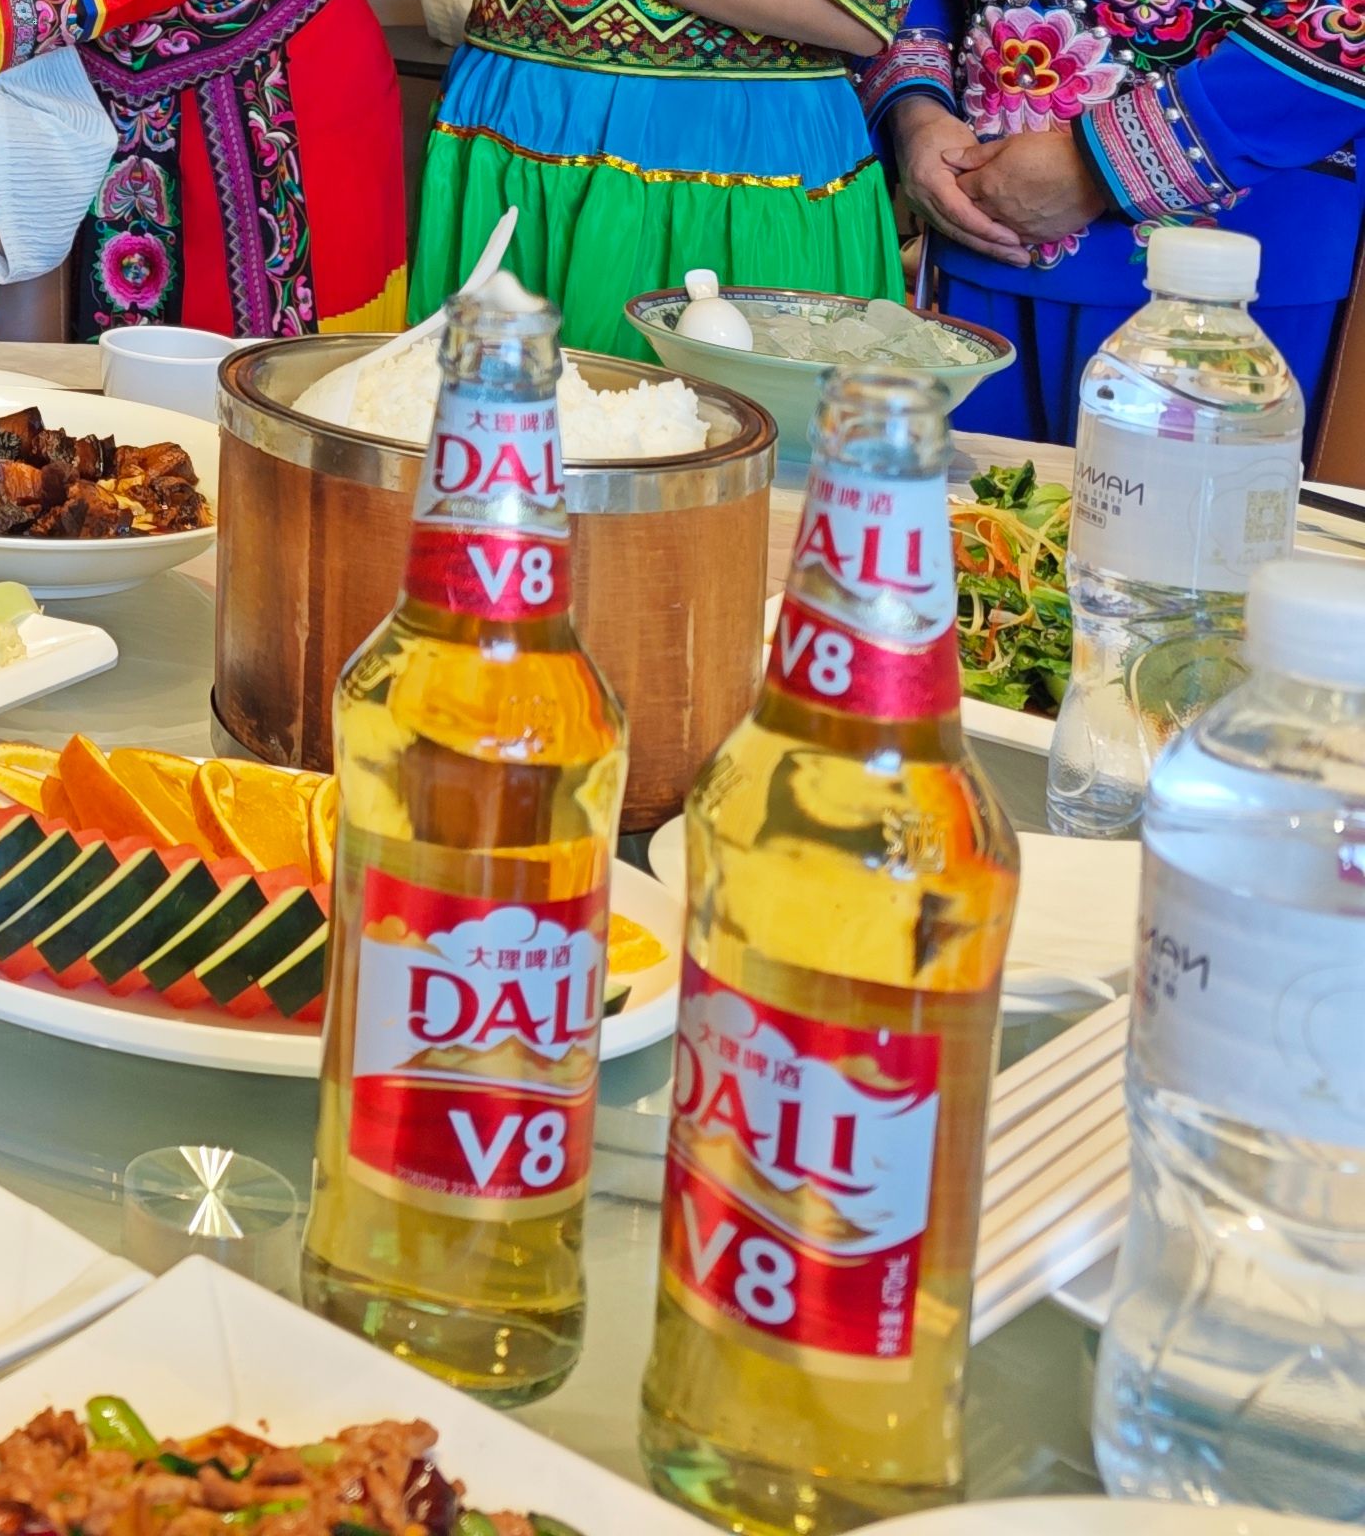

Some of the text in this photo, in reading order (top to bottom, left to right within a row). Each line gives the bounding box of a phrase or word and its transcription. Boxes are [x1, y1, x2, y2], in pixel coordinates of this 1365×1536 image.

[433, 432, 566, 495] DAL
[810, 474, 893, 516] 理啤酒
[467, 546, 554, 605] V8
[795, 511, 936, 594] ALI
[779, 615, 855, 697] V8
[465, 944, 573, 972] 大理啤酒
[407, 965, 598, 1045] DALI
[695, 1020, 804, 1092] 大理啤酒
[447, 1109, 568, 1190] V8
[680, 1190, 797, 1326] V8
